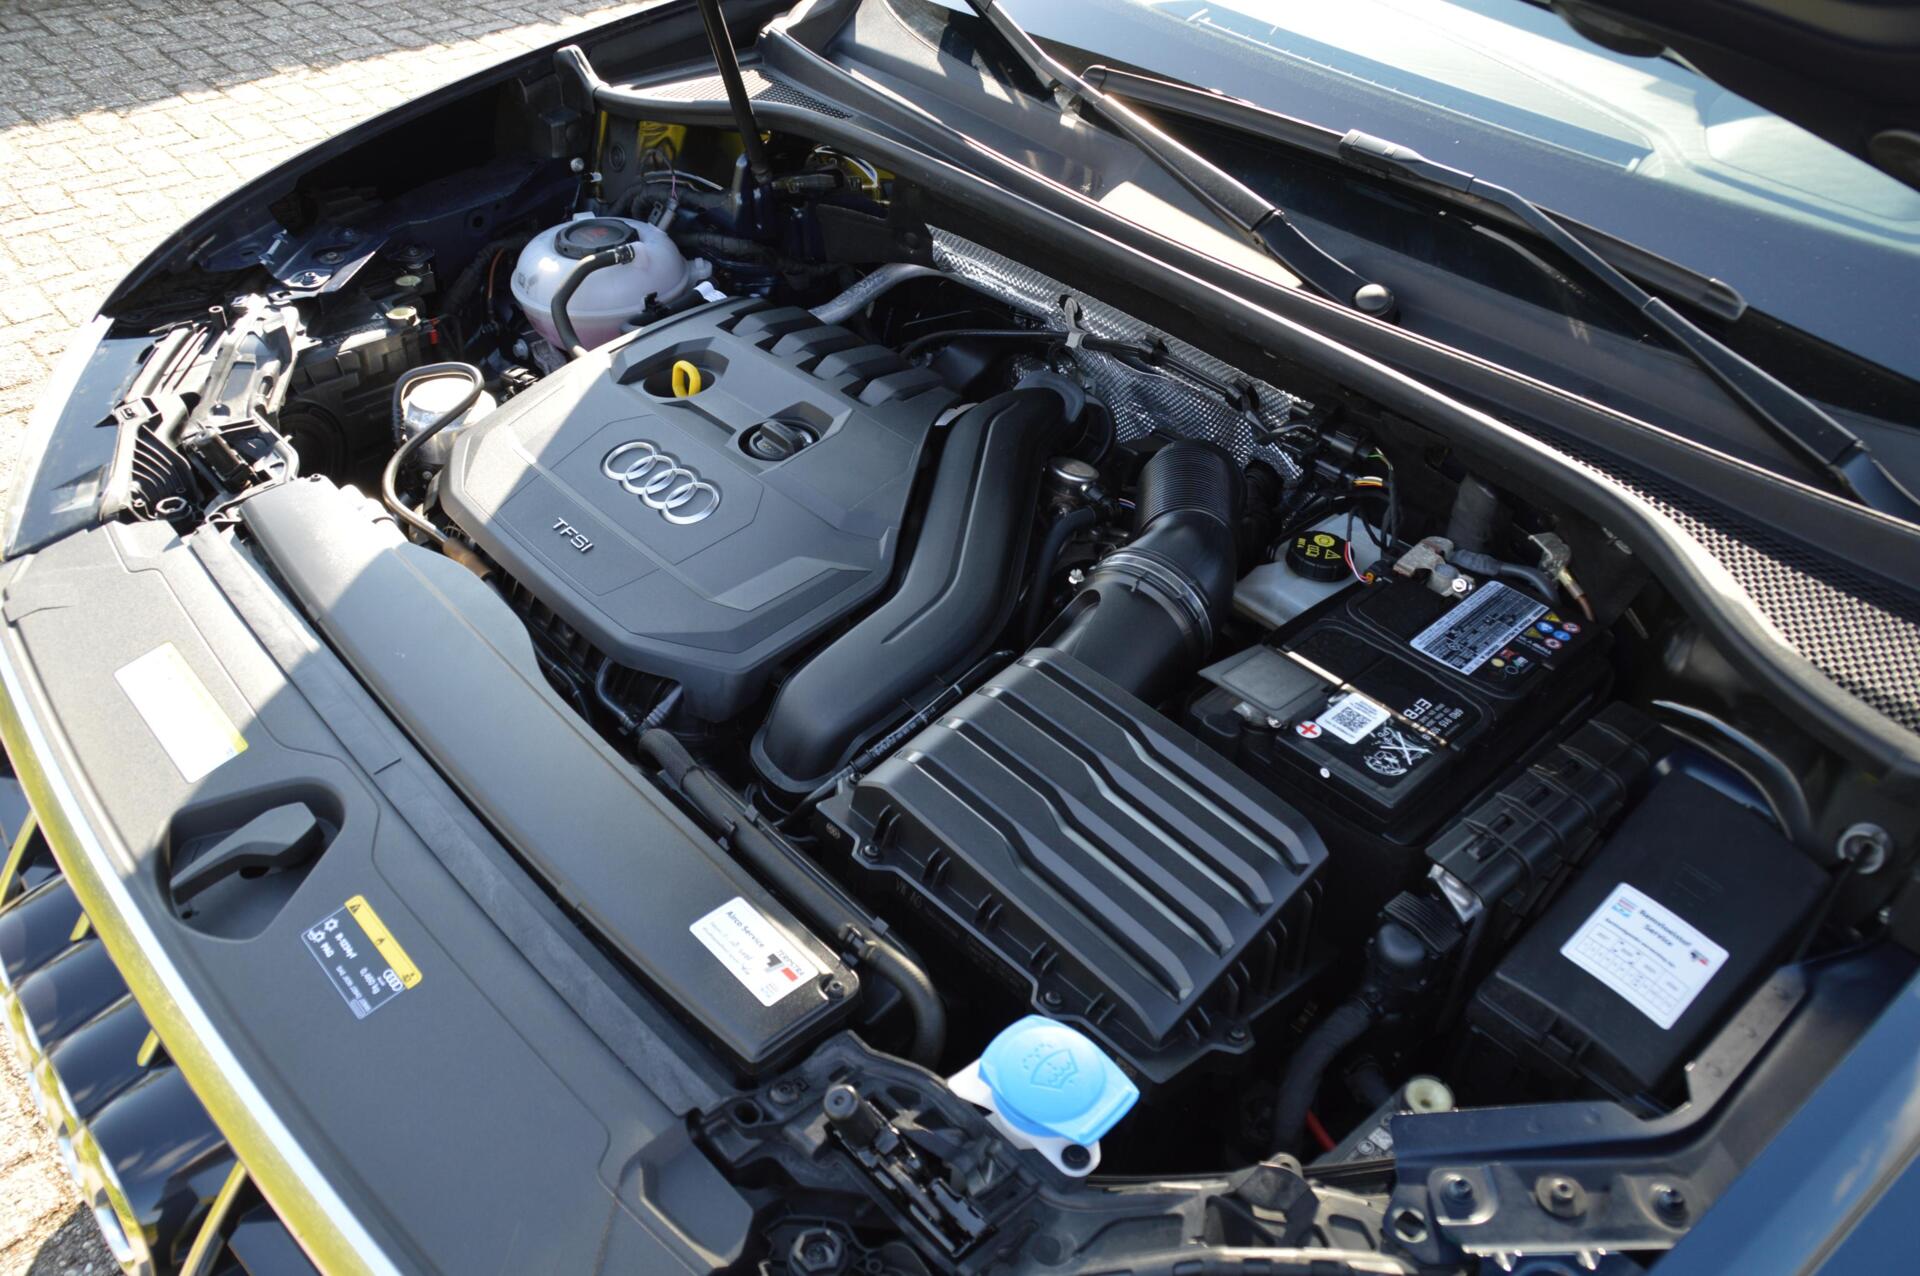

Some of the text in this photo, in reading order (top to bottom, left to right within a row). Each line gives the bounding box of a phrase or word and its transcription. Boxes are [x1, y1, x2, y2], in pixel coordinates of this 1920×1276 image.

[553, 516, 593, 552] TFSI
[1403, 698, 1432, 720] EFB
[726, 910, 743, 928] Airco
[742, 925, 765, 948] Service
